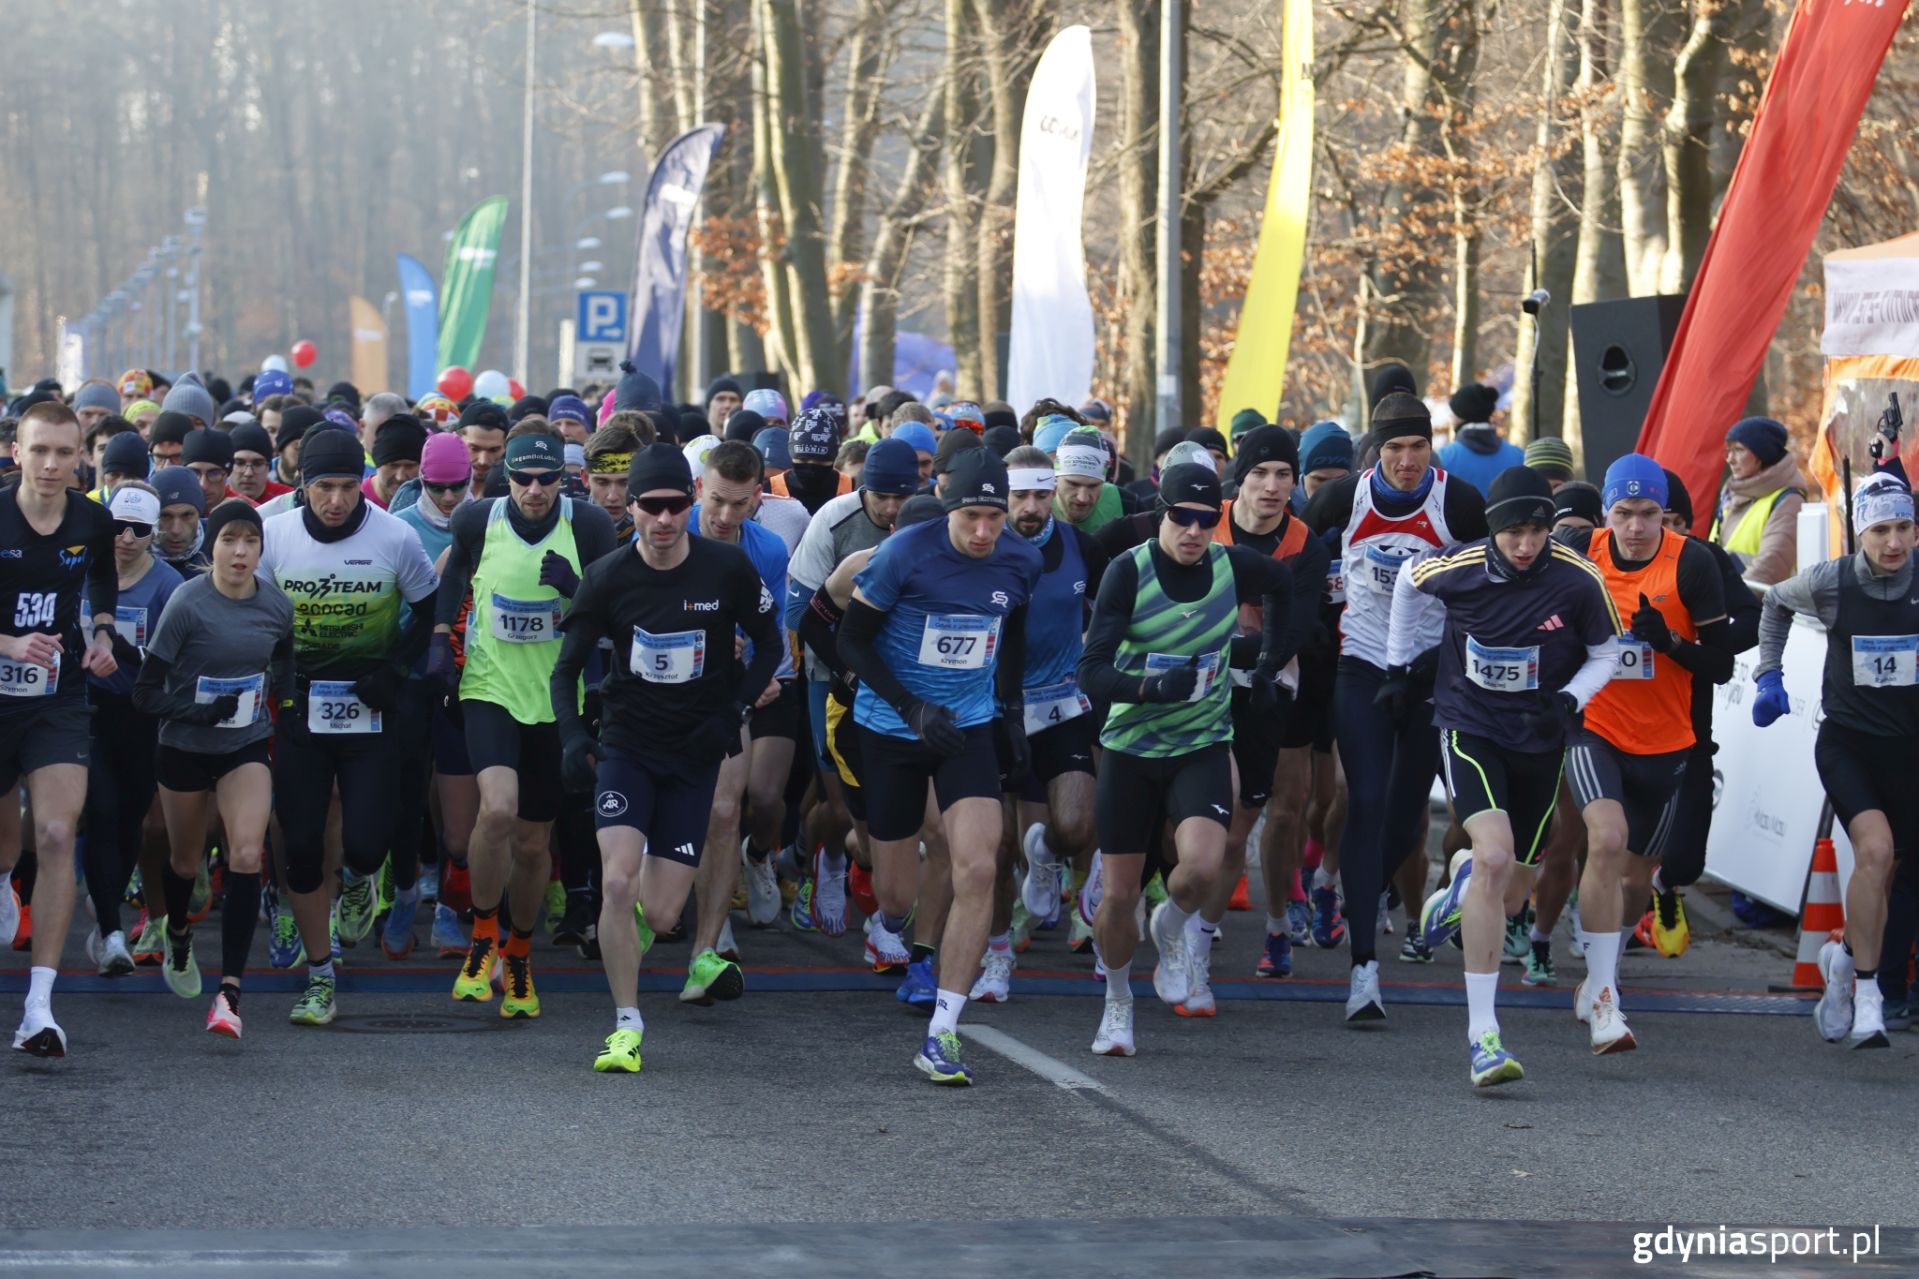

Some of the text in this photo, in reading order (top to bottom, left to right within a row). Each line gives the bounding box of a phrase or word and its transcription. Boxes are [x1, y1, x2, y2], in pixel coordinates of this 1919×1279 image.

[587, 296, 617, 337] P
[14, 592, 57, 627] 534
[300, 602, 367, 616] ecocad
[500, 614, 544, 632] 1178
[937, 636, 977, 655] 677
[654, 654, 668, 671] 5
[1473, 659, 1520, 681] 1475
[1873, 656, 1897, 674] 14
[1, 665, 38, 684] 316
[321, 702, 360, 720] 326
[1048, 705, 1062, 722] 4
